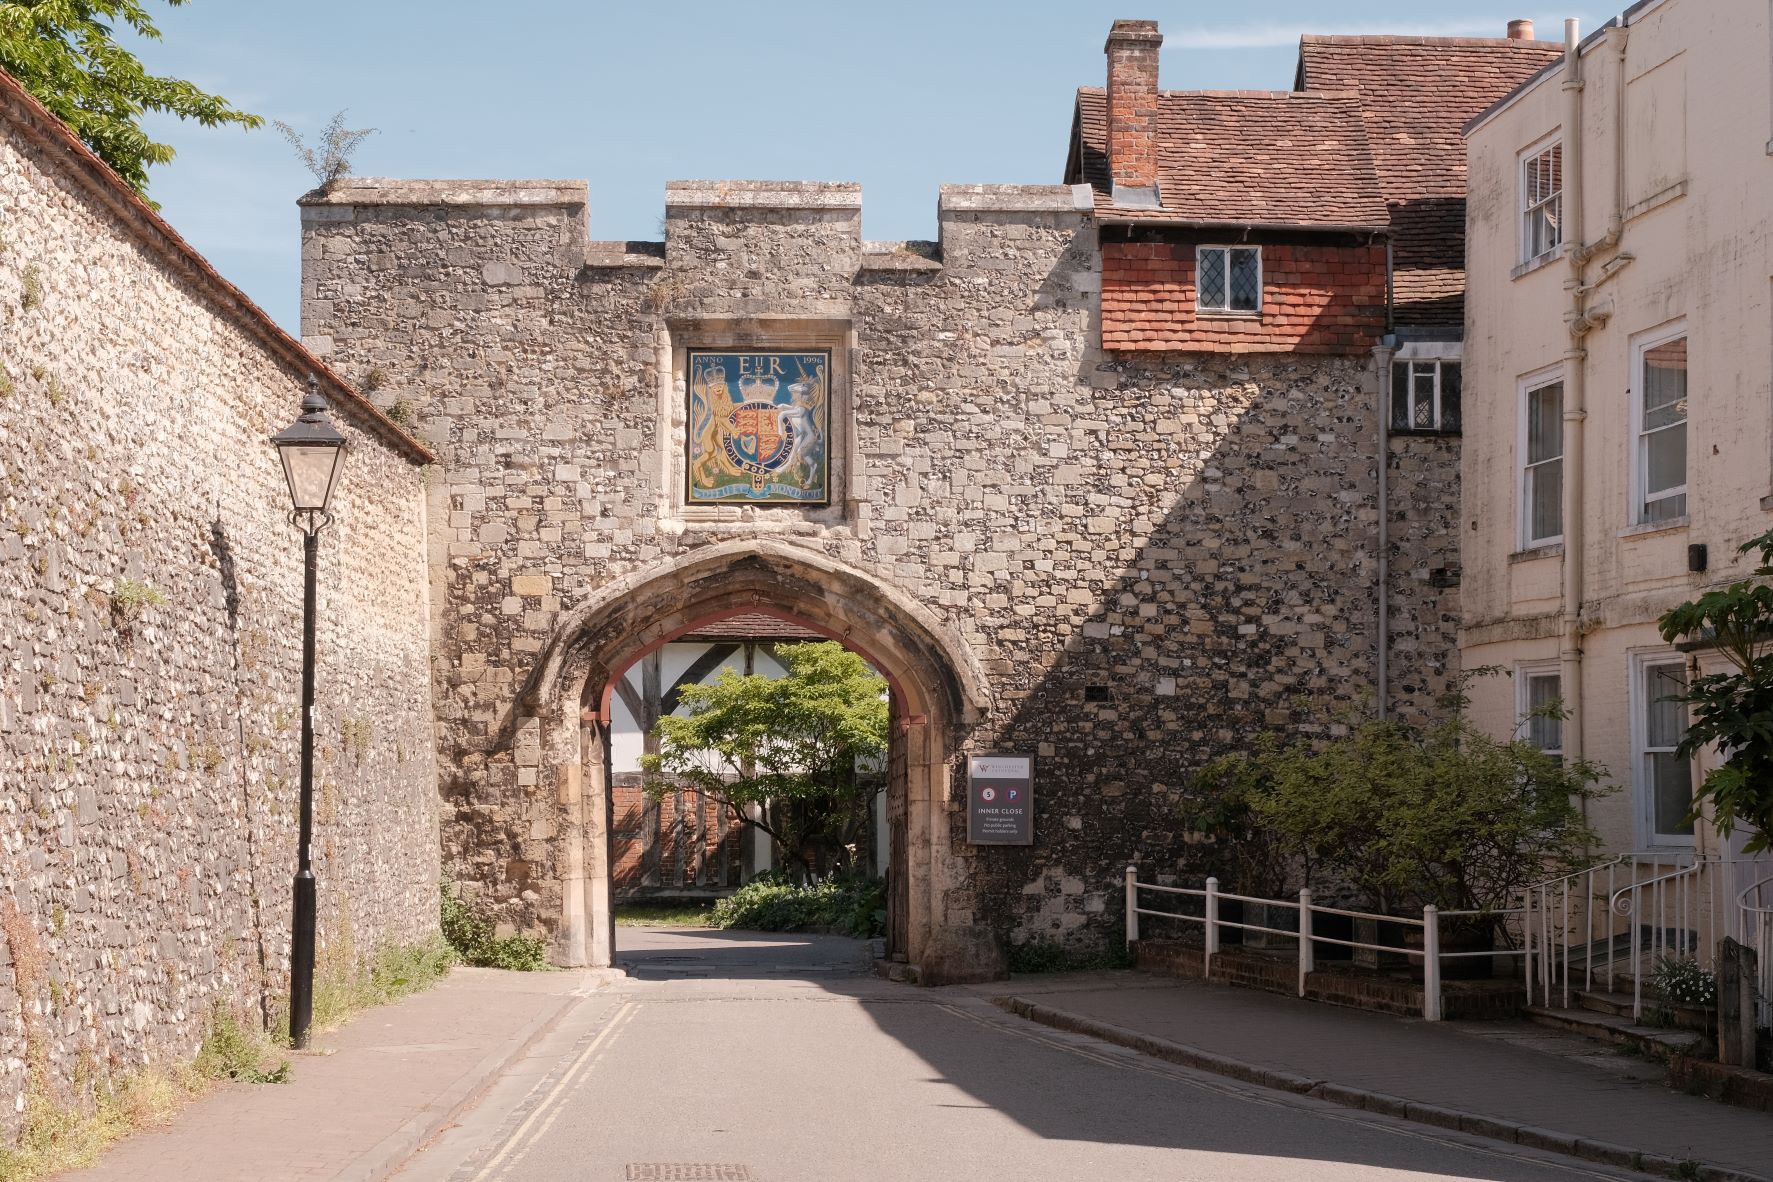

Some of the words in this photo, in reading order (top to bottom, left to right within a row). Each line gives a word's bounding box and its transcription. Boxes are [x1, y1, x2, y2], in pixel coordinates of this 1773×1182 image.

[695, 356, 724, 364] ANNO
[739, 356, 752, 374] E
[770, 356, 788, 374] R
[1010, 790, 1017, 799] P
